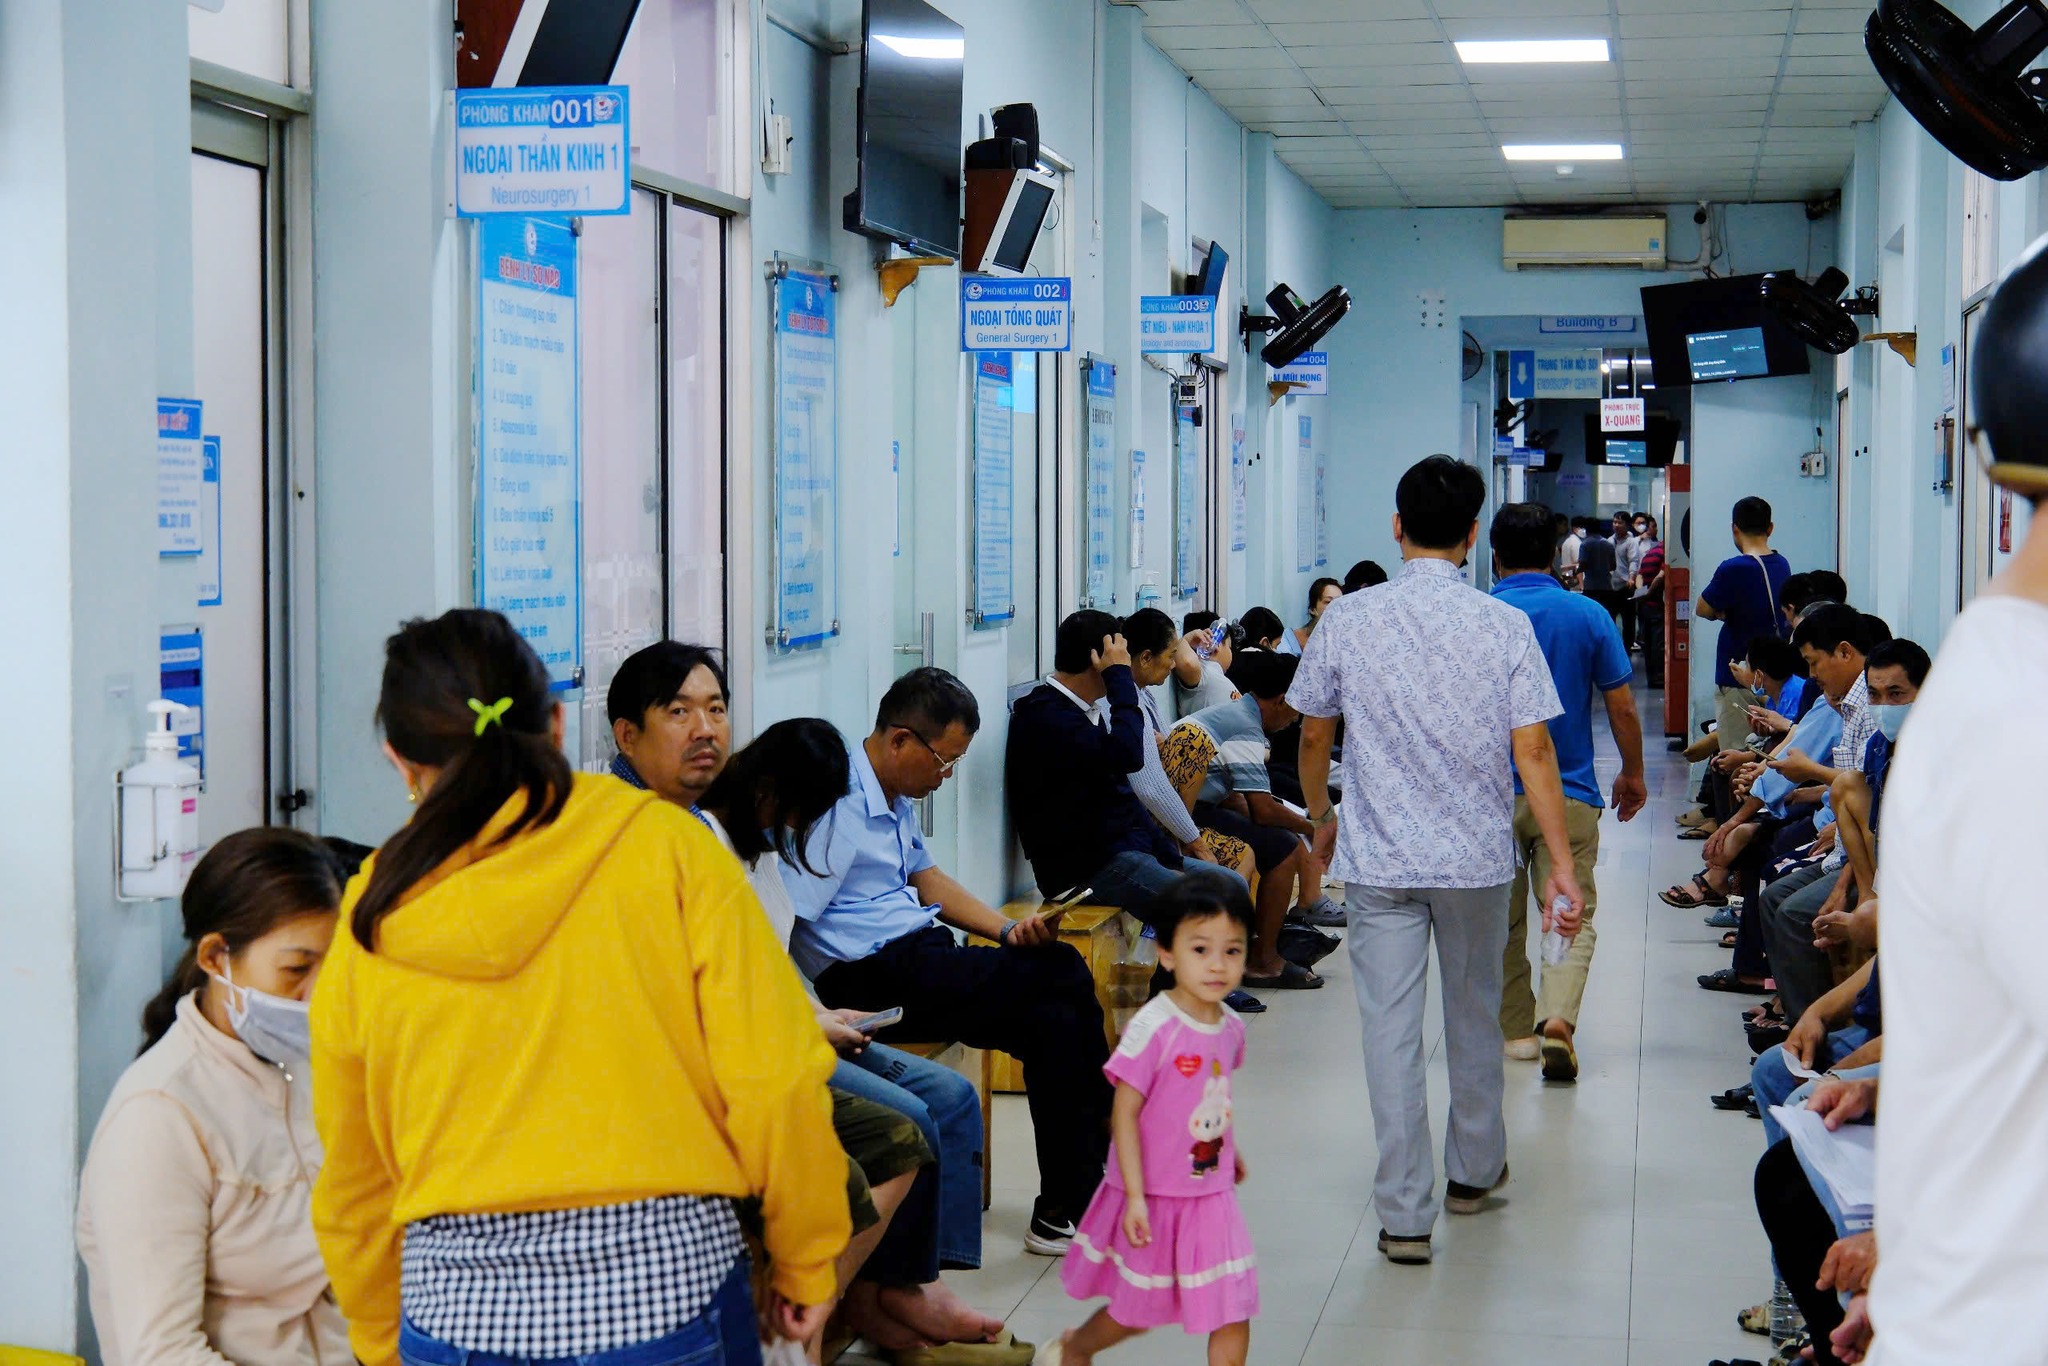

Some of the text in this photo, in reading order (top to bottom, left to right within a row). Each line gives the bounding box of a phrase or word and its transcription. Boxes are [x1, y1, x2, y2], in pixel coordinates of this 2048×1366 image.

[462, 100, 509, 124] PHÒNG
[551, 99, 592, 124] 001
[463, 144, 512, 179] NGOẠI
[567, 143, 604, 171] KINH
[611, 143, 618, 170] 1
[492, 186, 591, 208] Neurosurgery 1
[983, 284, 1060, 298] PHÒNG KHÁM 002
[1180, 300, 1199, 311] 003
[970, 303, 1062, 329] NGOẠI TỔNG QUÁT
[1206, 321, 1209, 333] 1
[1556, 317, 1617, 329] Building B
[976, 332, 1057, 345] General Surgery 1
[1310, 356, 1325, 364] 004
[1604, 403, 1623, 411] PHÒNG
[1605, 414, 1641, 427] X-QUANG
